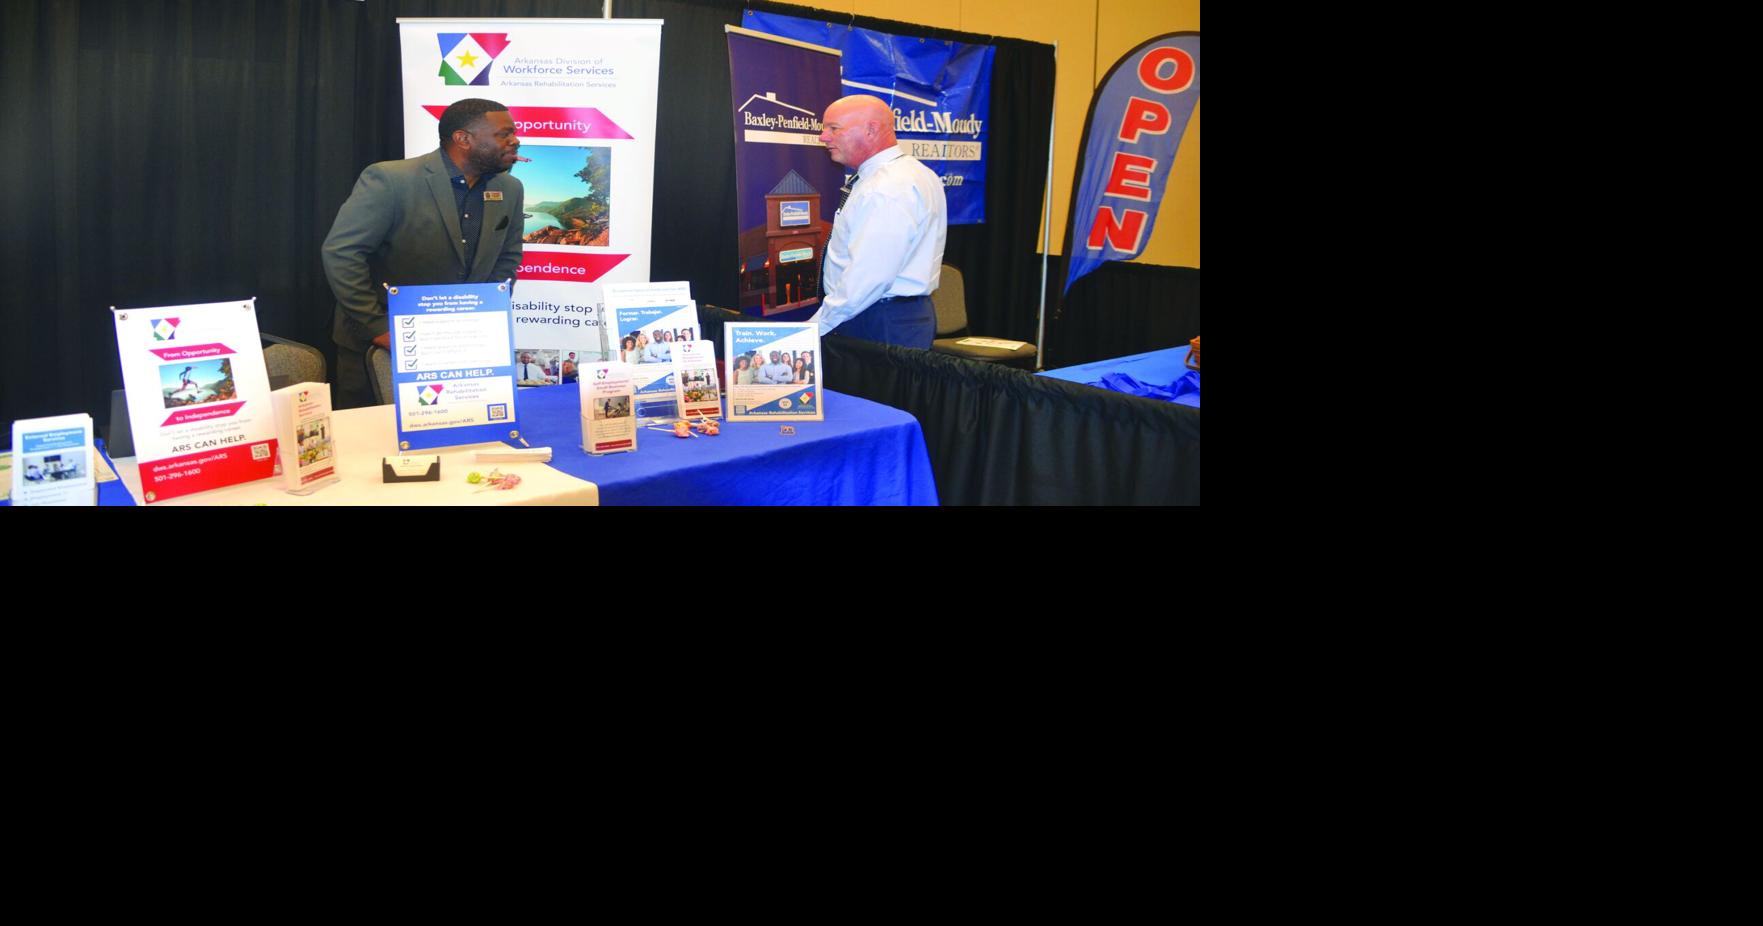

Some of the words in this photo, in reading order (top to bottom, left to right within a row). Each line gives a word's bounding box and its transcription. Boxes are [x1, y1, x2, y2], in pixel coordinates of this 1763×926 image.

[514, 57, 553, 65] Arkansas
[556, 57, 591, 65] Division
[594, 57, 603, 65] of
[503, 65, 563, 74] Workforce
[566, 66, 614, 75] Services
[514, 119, 592, 134] pportunity
[744, 111, 824, 131] Baxley-Penfield-Mou
[893, 108, 982, 139] field-Moudy
[1086, 46, 1196, 255] OPEN
[940, 174, 964, 187] com
[516, 262, 586, 275] pendence
[512, 301, 561, 314] isability
[564, 304, 593, 315] stop
[516, 315, 580, 328] rewarding
[416, 372, 437, 381] ARS
[440, 370, 463, 379] CAN
[465, 368, 495, 377] HELP.
[171, 443, 192, 453] ARS
[194, 439, 217, 449] CAN
[219, 434, 247, 444] HELP.
